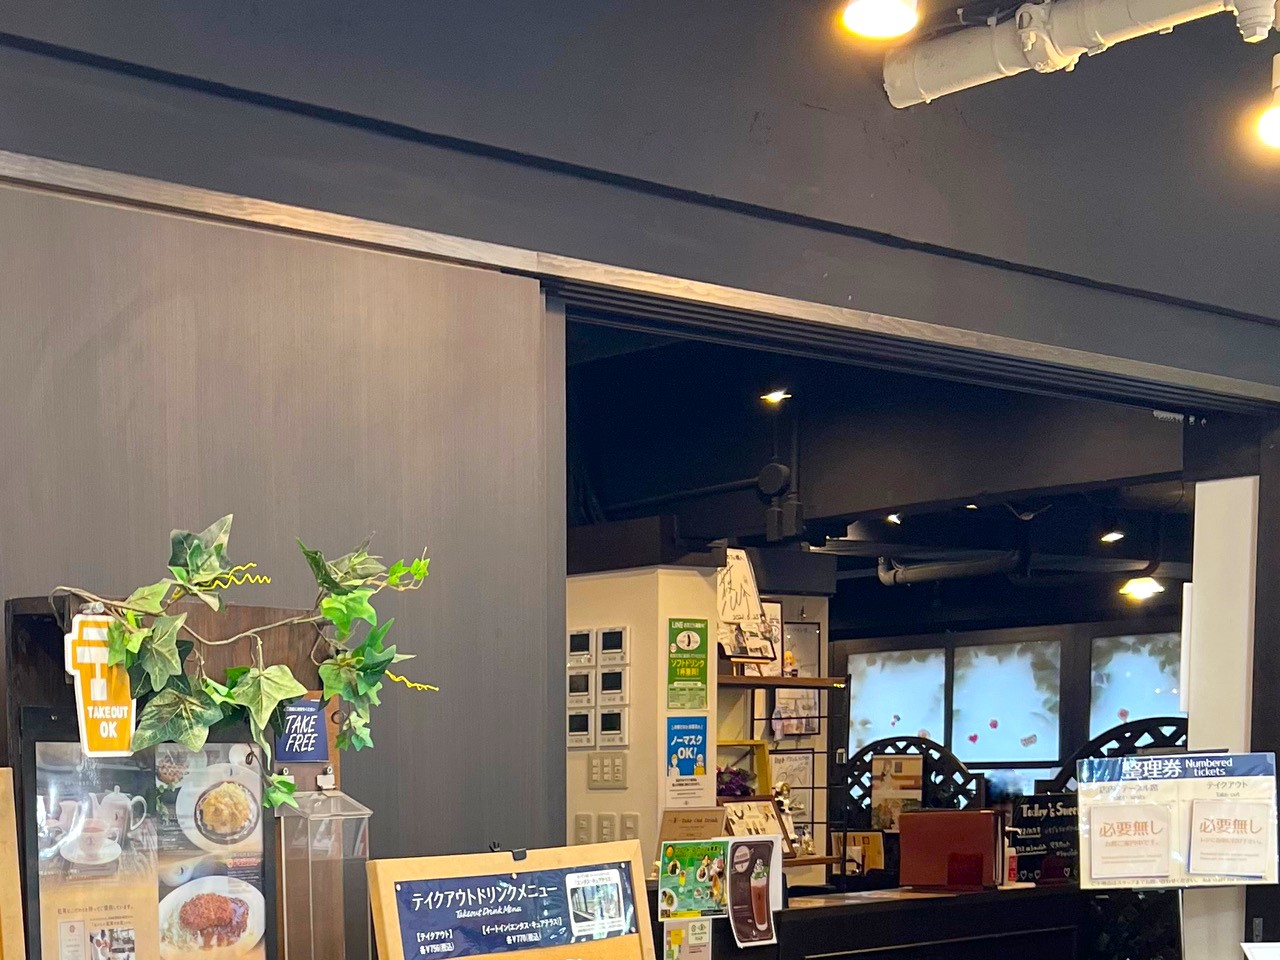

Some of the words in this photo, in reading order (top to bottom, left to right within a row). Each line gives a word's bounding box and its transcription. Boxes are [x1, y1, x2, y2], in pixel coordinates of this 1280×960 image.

[87, 705, 129, 719] TAKEOUT
[99, 720, 118, 738] OK
[285, 714, 319, 734] TAKE
[285, 733, 319, 752] FREE
[670, 735, 703, 746] ノーマスク
[677, 746, 698, 760] OK!
[1121, 759, 1182, 780] 整理券
[1185, 757, 1233, 768] Numbered
[1193, 766, 1227, 777] tickets
[1206, 780, 1248, 789] テイクアウト
[1021, 802, 1056, 821] Today's
[1099, 820, 1164, 838] 必要無し
[1200, 818, 1263, 835] 必要無し
[412, 883, 558, 911] テイクアウトドリンクメニュー
